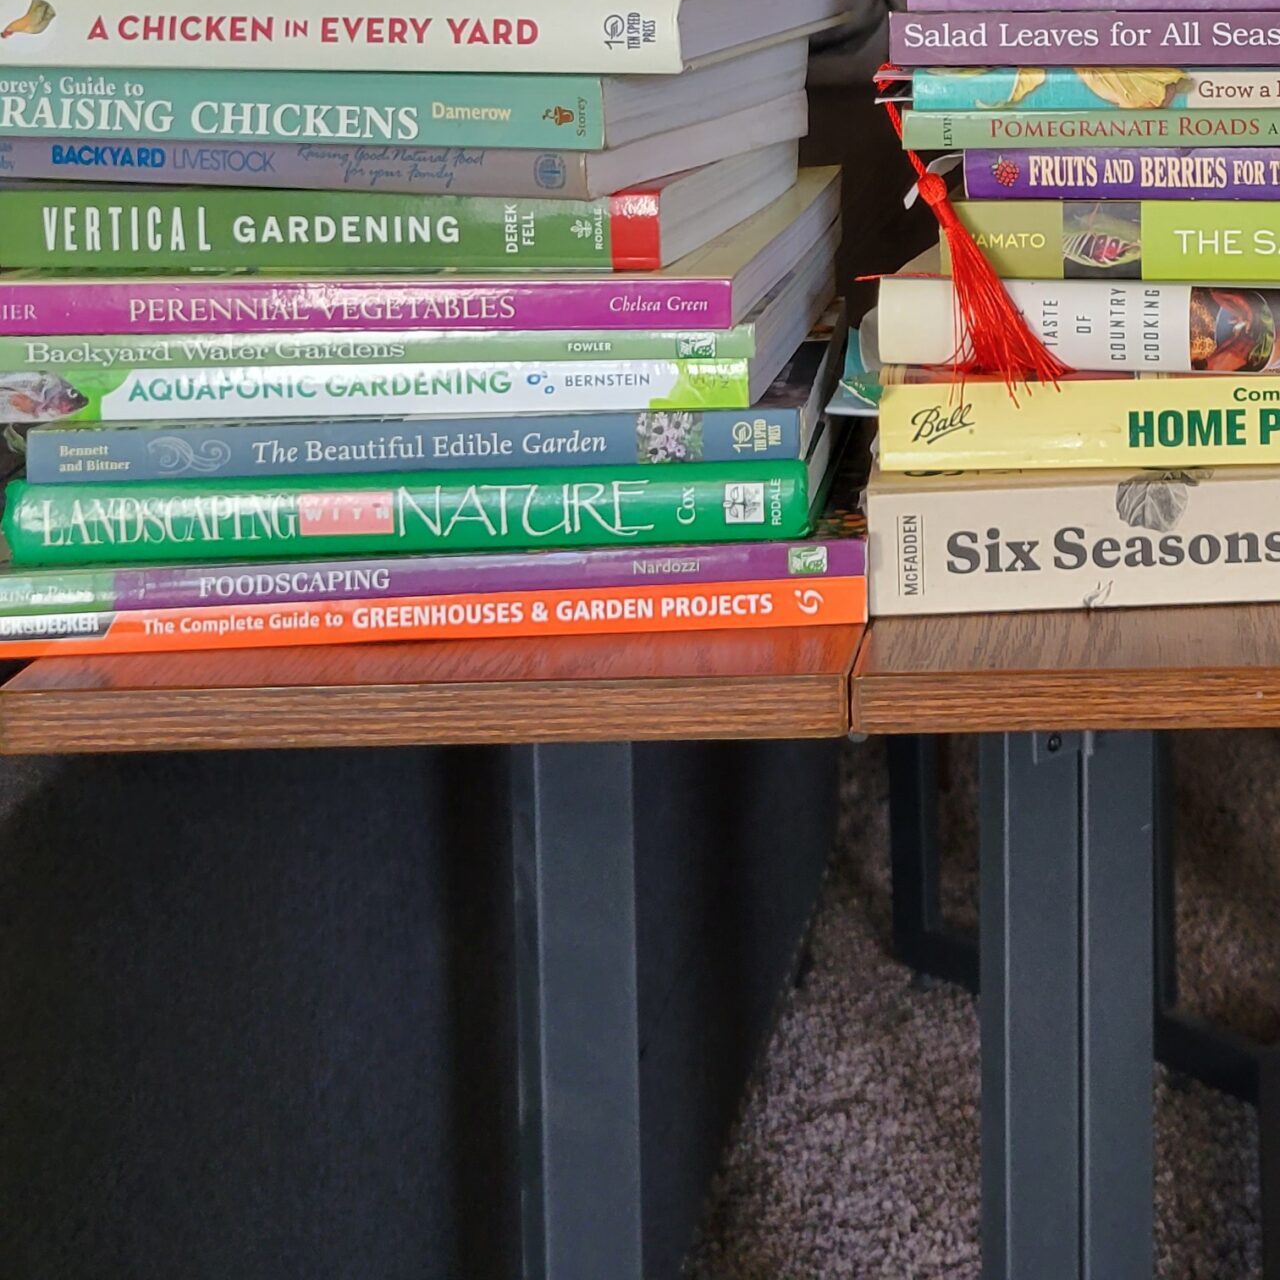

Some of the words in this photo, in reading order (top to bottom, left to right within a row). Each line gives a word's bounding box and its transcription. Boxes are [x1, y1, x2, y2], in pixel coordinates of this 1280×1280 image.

[87, 15, 109, 40] A
[117, 16, 274, 42] CHICKEN
[285, 21, 308, 37] IN
[320, 17, 432, 44] EVERY
[446, 18, 539, 44] YARD
[1, 97, 175, 132] RAISING
[190, 100, 419, 140] CHICKENS
[431, 101, 512, 121] Damerow
[52, 145, 165, 168] BACKYARD
[173, 149, 276, 172] LIVESTOCK
[43, 207, 212, 252] VERTICAL
[233, 216, 459, 244] GARDENING
[506, 204, 518, 253] DEREK
[523, 211, 534, 246] FELL
[610, 296, 661, 313] Chelsea
[667, 295, 708, 312] Green
[1111, 288, 1126, 361] COUNTRY
[1144, 289, 1159, 361] COOKING
[568, 342, 611, 352] FOWLER
[565, 374, 650, 387] BERNSTEIN
[1128, 408, 1246, 447] HOME
[59, 445, 108, 457] Bennett
[252, 440, 298, 463] The
[306, 436, 424, 461] Beautiful
[433, 435, 512, 457] Edible
[523, 434, 607, 453] Garden
[59, 460, 82, 471] and
[86, 458, 130, 470] Bittner
[946, 528, 1041, 574] Six
[633, 559, 700, 575] Nardozzi
[200, 569, 390, 596] FOODSCAPING
[144, 620, 174, 634] The
[180, 614, 265, 634] Complete
[270, 614, 320, 630] Guide
[325, 613, 343, 627] to
[352, 603, 523, 628] GREENHOUSES
[531, 605, 548, 623] &
[557, 600, 652, 621] GARDEN
[662, 593, 773, 616] PROJECTS
